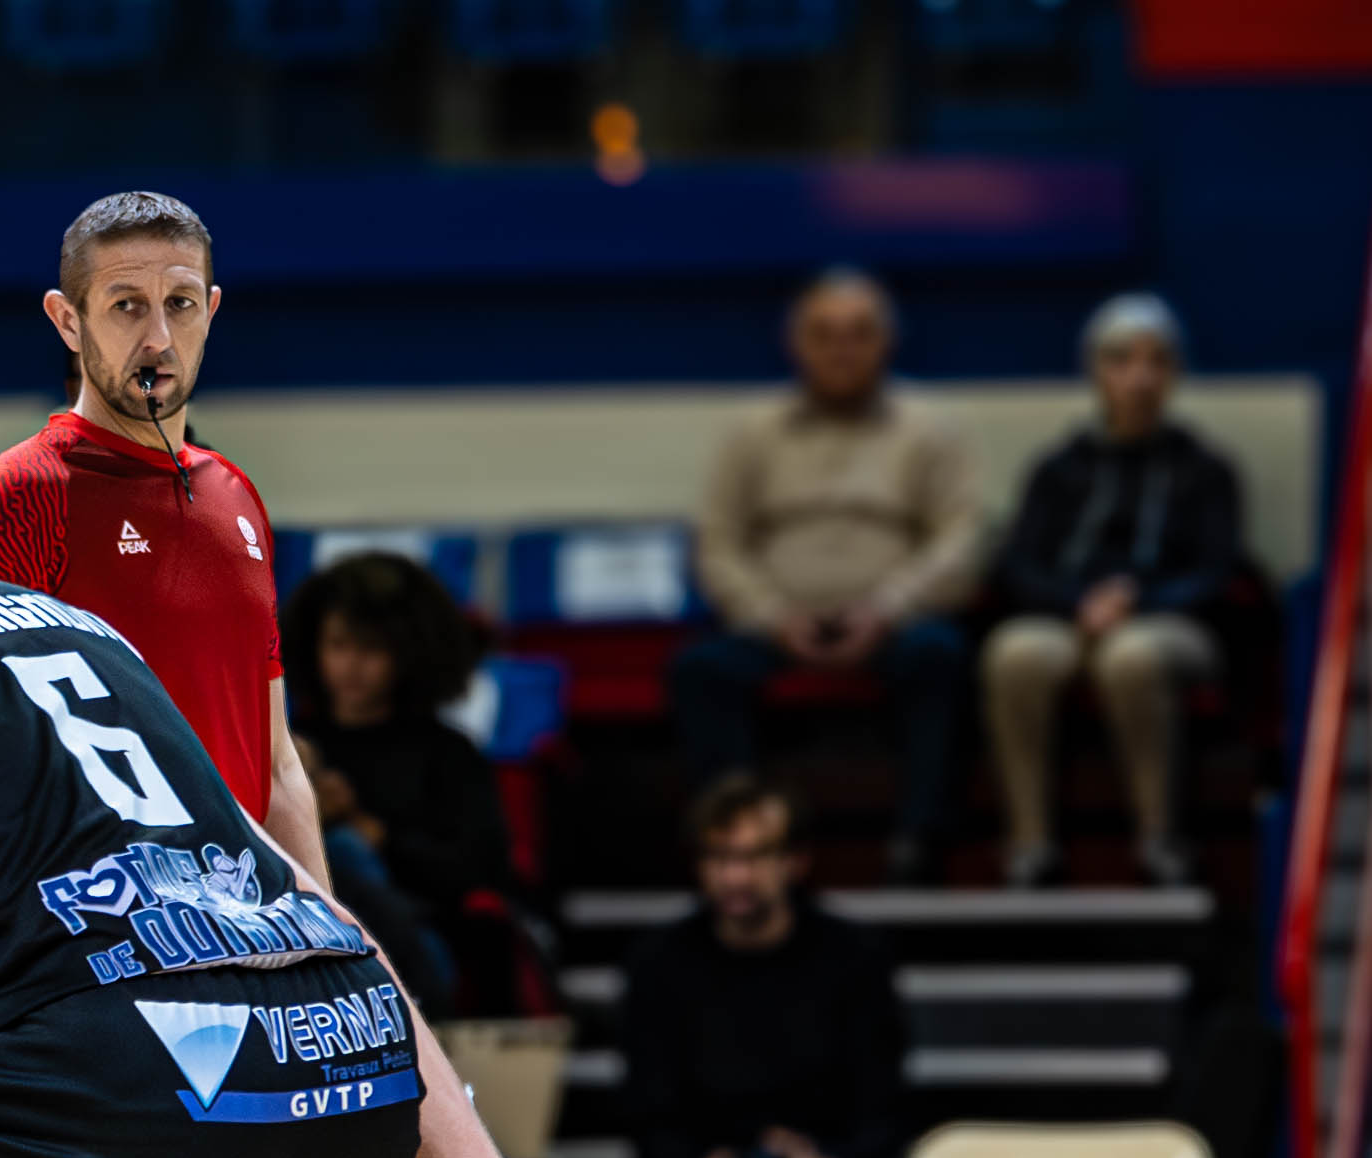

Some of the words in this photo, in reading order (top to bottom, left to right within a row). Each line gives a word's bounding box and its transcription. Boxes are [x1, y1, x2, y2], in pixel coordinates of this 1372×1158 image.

[117, 539, 152, 555] PEAK
[2, 651, 195, 827] 6
[87, 940, 146, 984] DE
[251, 983, 406, 1064] VERNAT
[290, 1081, 373, 1118] GVTP
